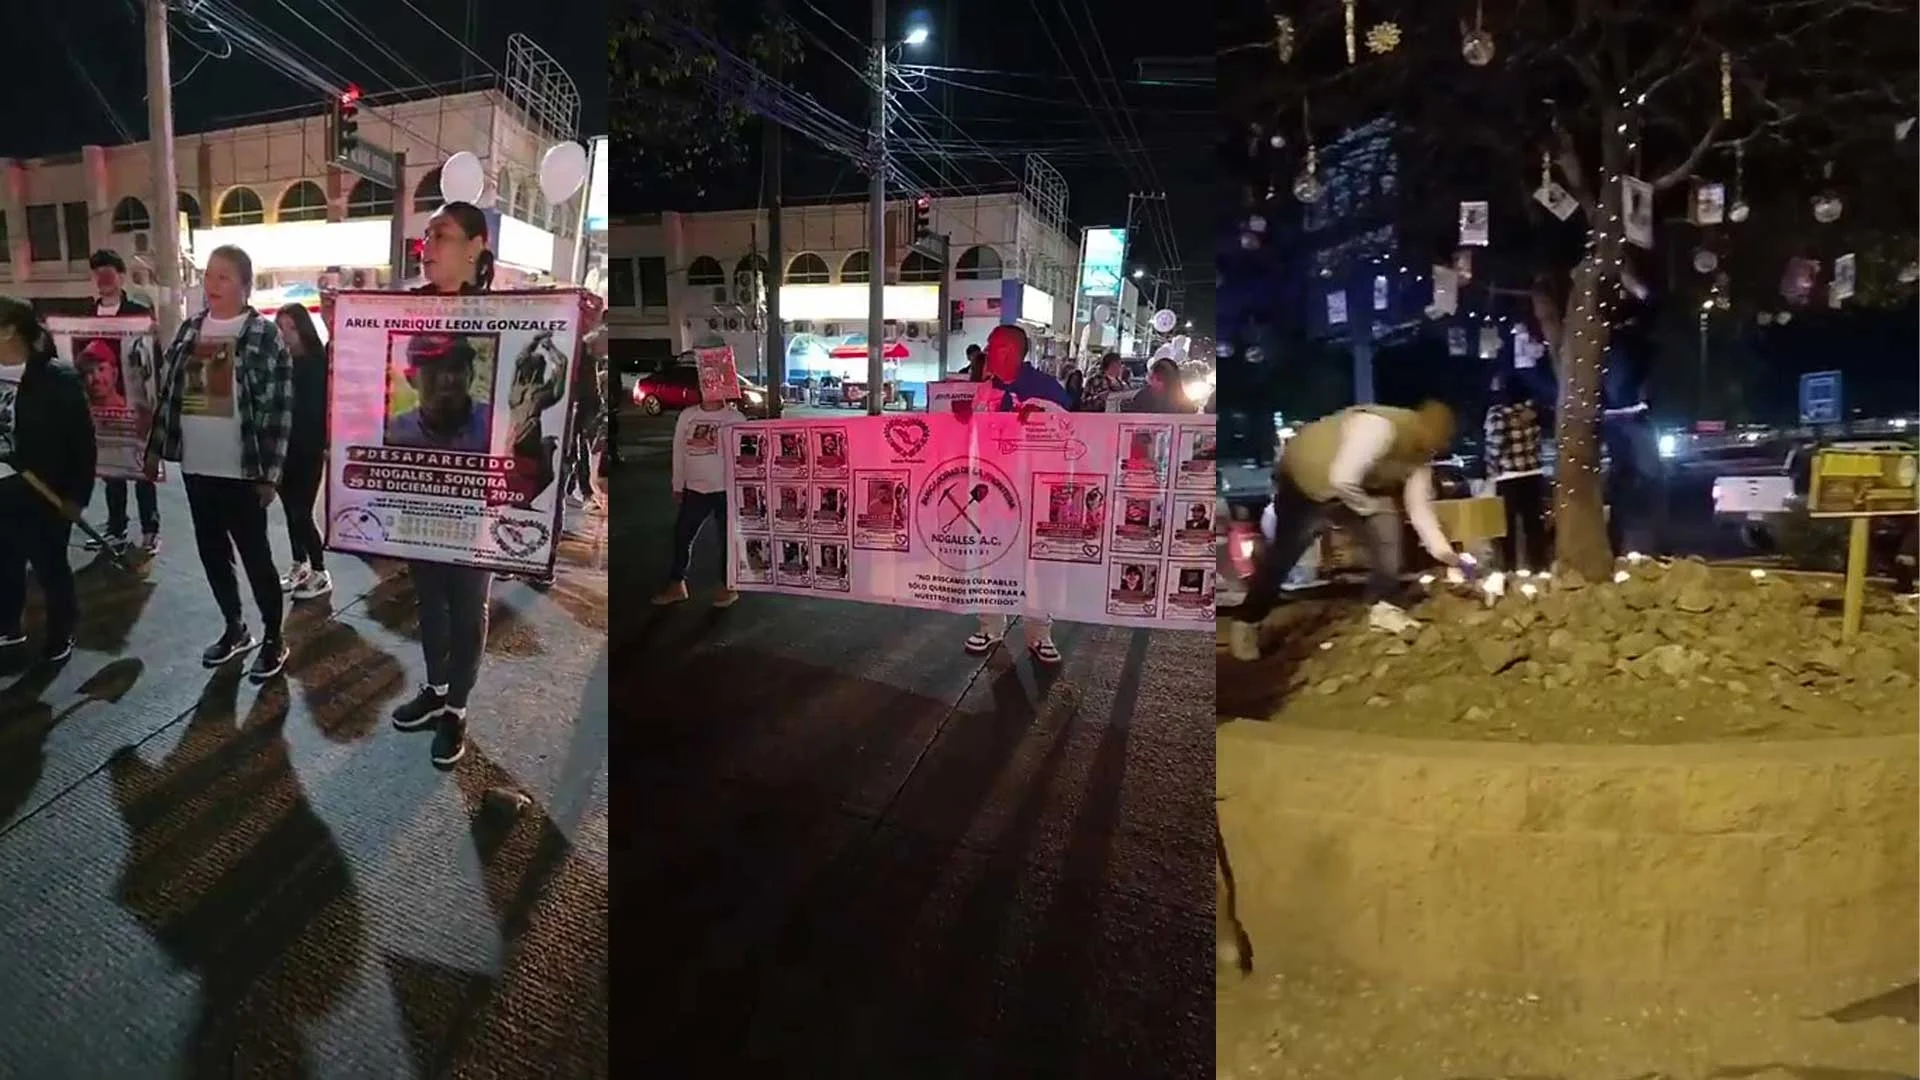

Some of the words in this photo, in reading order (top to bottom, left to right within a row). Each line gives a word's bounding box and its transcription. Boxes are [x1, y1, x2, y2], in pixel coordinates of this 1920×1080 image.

[345, 318, 380, 329] ARIEL
[384, 318, 442, 331] ENRIQUE
[445, 319, 483, 330] LEON
[486, 320, 568, 331] GONZALEZ
[366, 449, 516, 470] DESAPARECIDO
[370, 468, 434, 483] NOGALES
[444, 473, 508, 489] SONORA
[349, 478, 365, 488] 29
[367, 480, 384, 489] DE
[386, 480, 459, 496] DICIEMBRE
[461, 486, 487, 499] DEL
[490, 489, 525, 502] 2020
[931, 534, 975, 545] NOGALES
[979, 536, 1001, 546] A.C.
[932, 575, 971, 585] BUSCAMOS
[972, 578, 1018, 587] CULPABLES
[928, 584, 966, 595] QUEREMOS
[968, 586, 1018, 596] ENCONTRAR
